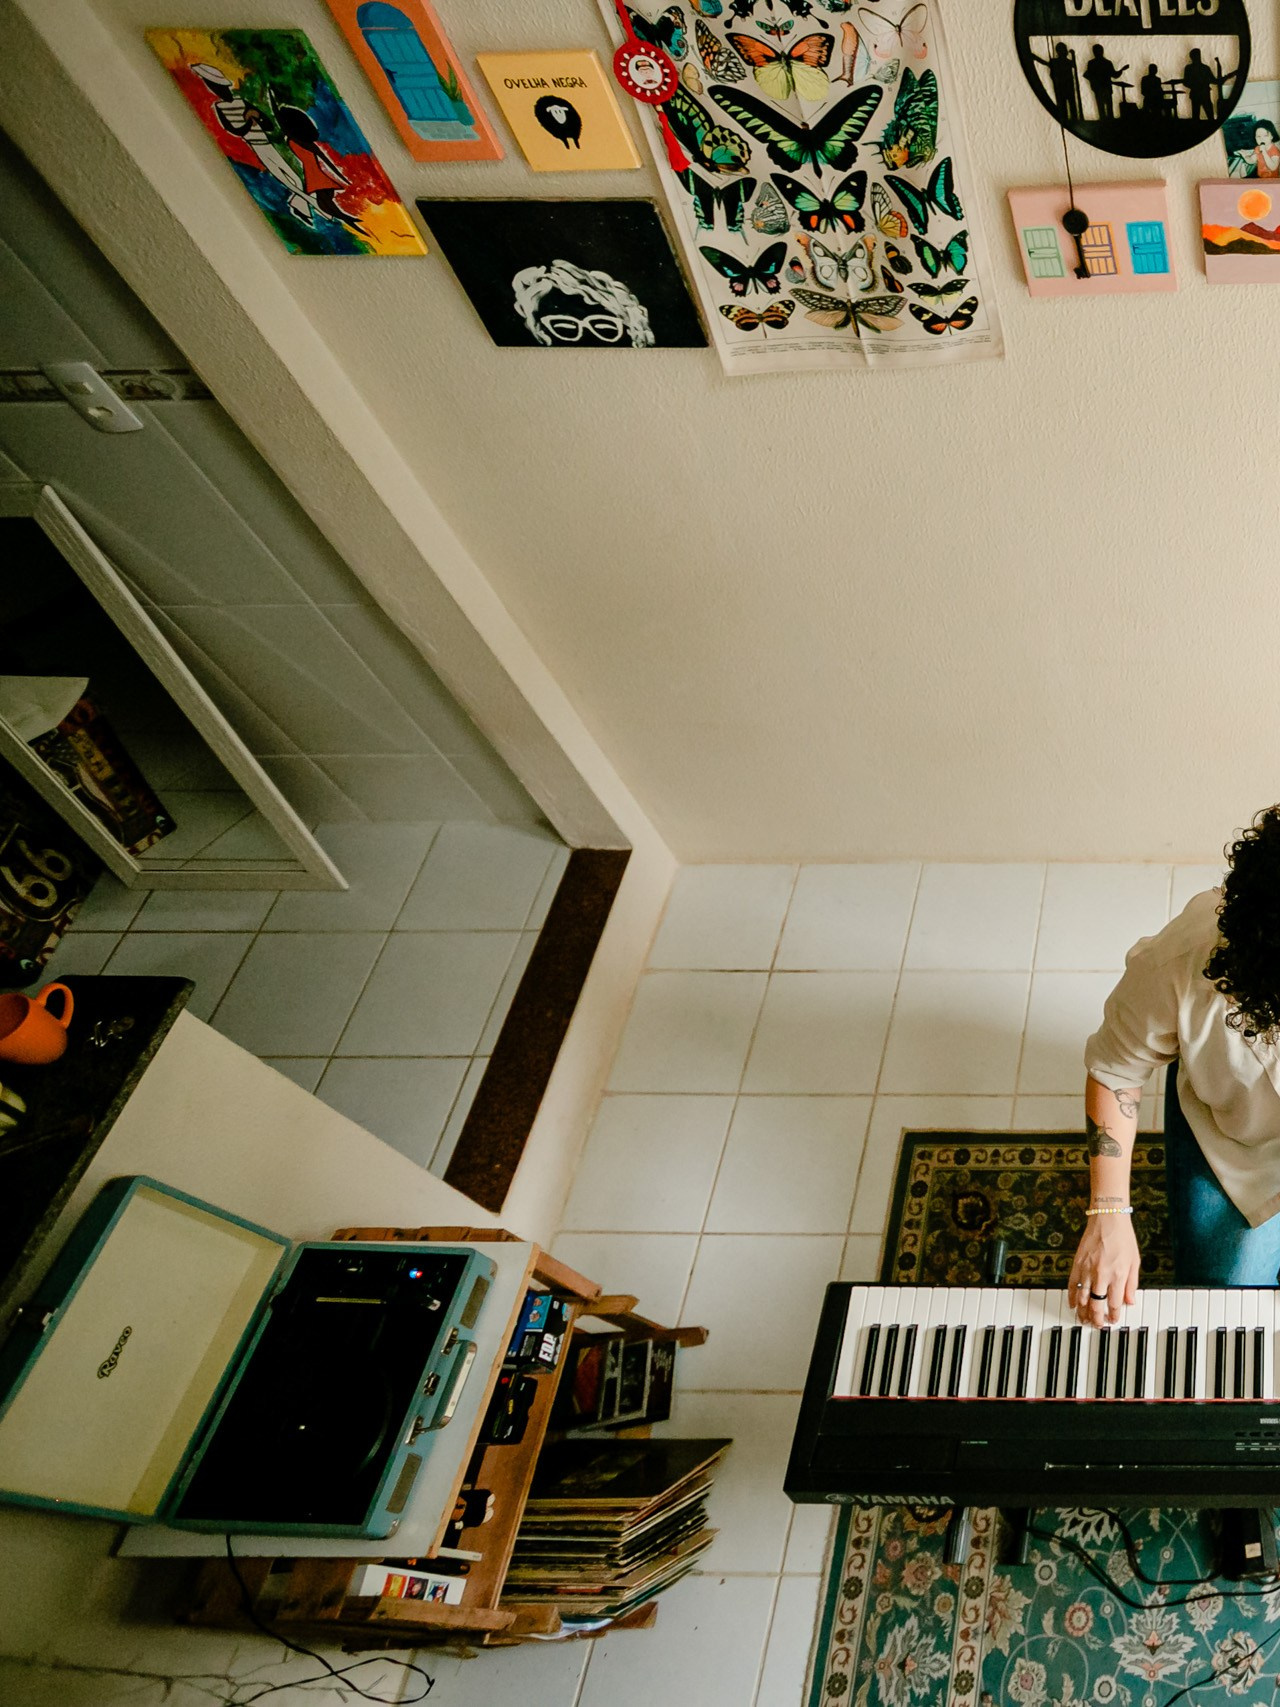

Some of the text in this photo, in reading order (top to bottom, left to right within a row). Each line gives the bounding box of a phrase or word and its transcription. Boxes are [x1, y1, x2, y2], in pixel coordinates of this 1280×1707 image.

[503, 77, 588, 89] OVELHA NEGRA
[855, 1495, 956, 1505] YAMAHA
